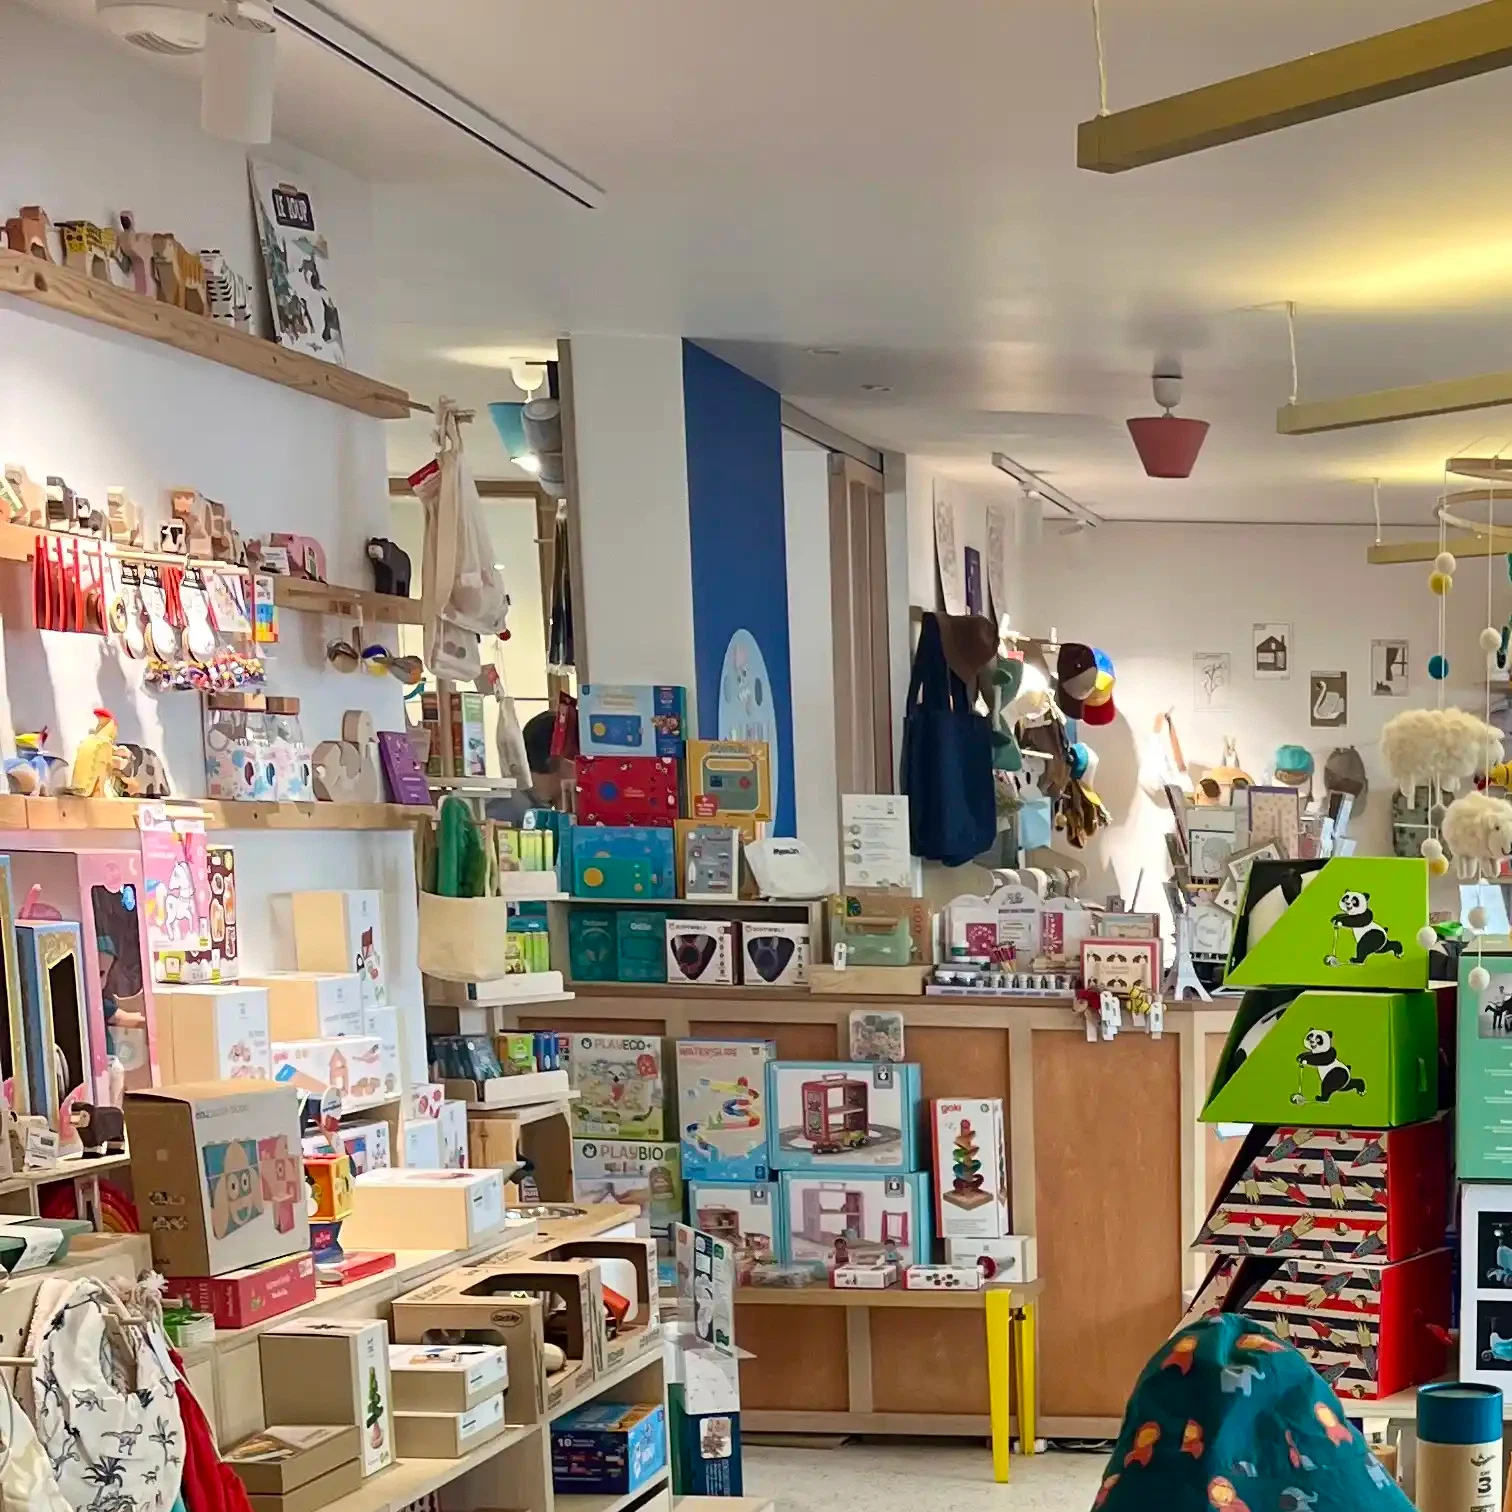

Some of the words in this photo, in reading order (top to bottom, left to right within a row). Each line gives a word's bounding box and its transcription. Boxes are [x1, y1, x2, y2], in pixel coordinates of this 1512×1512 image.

[594, 1040, 652, 1050] PLAYECO+
[941, 1104, 962, 1116] goki
[601, 1145, 664, 1160] PLAYBIO
[557, 1437, 572, 1448] 10
[1478, 1476, 1492, 1493] 3
